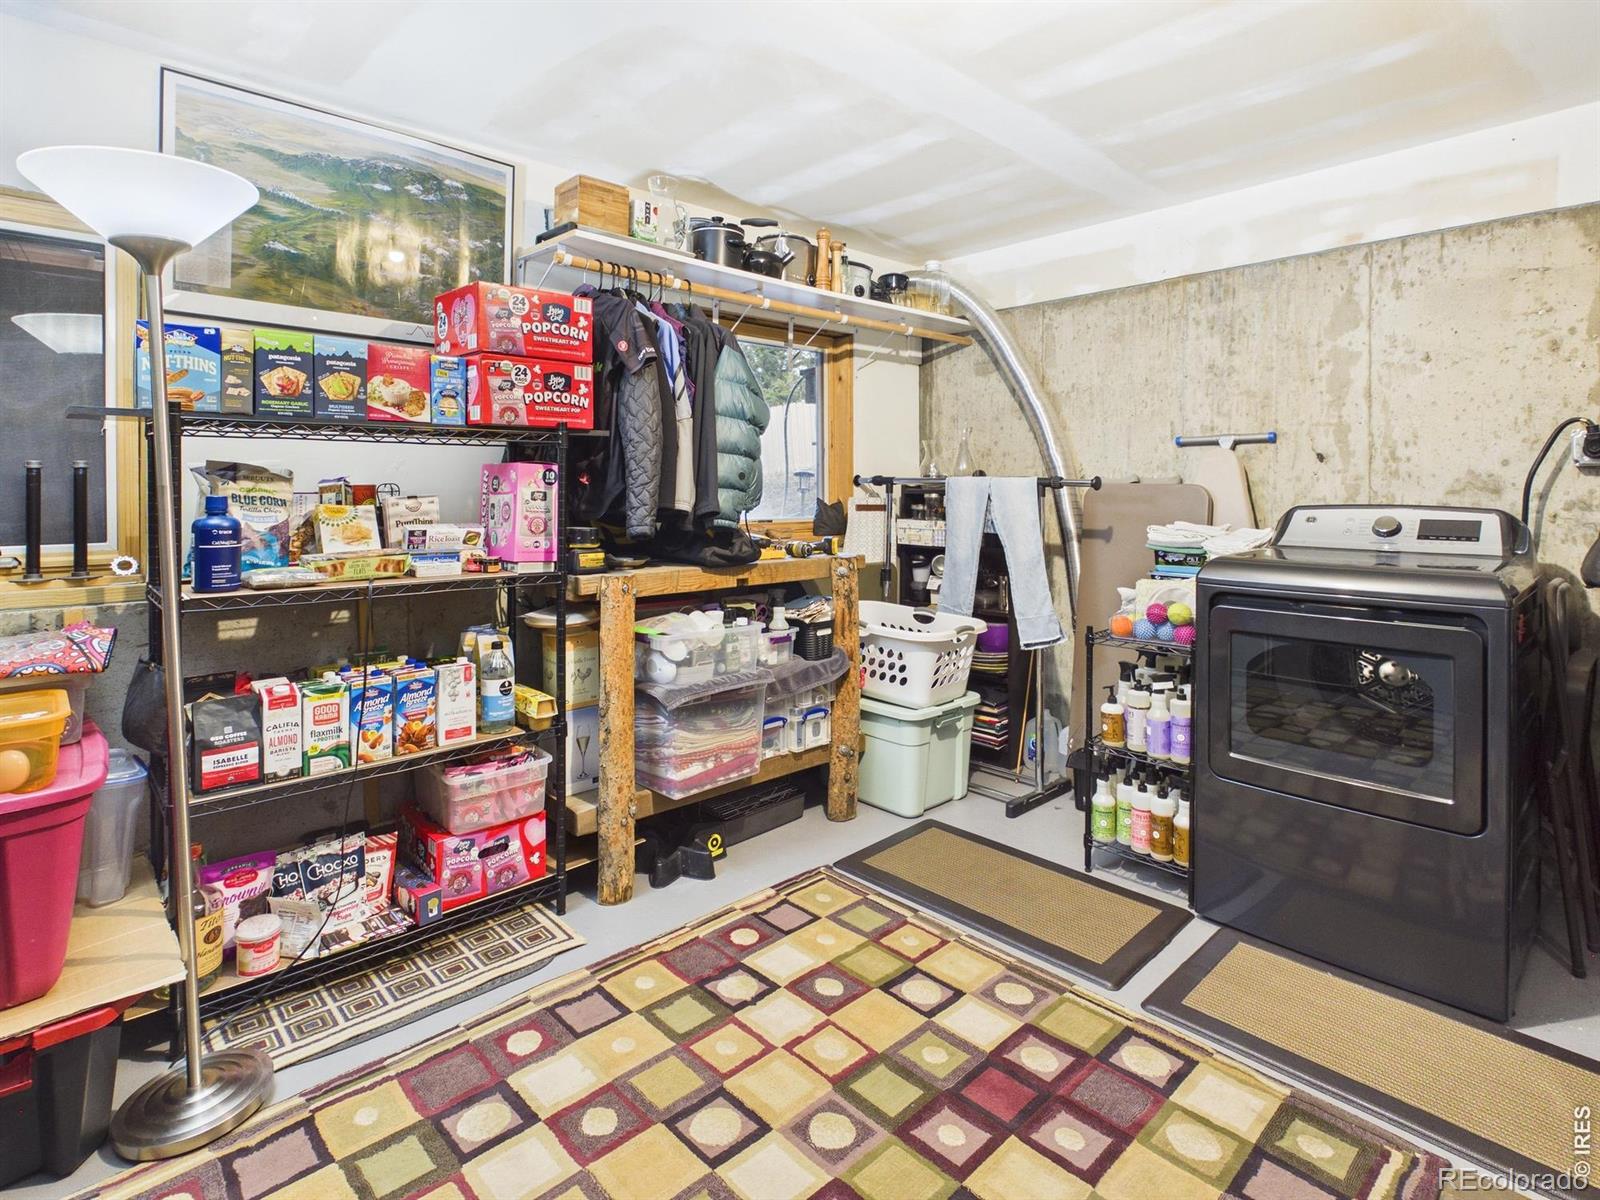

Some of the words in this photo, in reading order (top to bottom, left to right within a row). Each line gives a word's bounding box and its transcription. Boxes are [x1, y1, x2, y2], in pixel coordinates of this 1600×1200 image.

[512, 295, 526, 306] 24
[522, 322, 589, 342] POPCORN
[533, 335, 569, 346] SWEETHEART
[268, 354, 302, 362] patagonia
[141, 354, 218, 375] NT-THINS
[514, 366, 528, 377] 24
[524, 391, 589, 409] POPCORN
[535, 405, 571, 413] SWEETHEART
[545, 472, 555, 480] 10
[239, 487, 277, 495] ORGANIC
[231, 492, 258, 506] BLUE
[258, 495, 287, 508] CORN
[239, 505, 262, 514] Tortilla
[263, 506, 282, 515] Chips
[400, 686, 434, 705] Almond
[314, 703, 338, 714] GOOD
[354, 693, 391, 713] Amond
[314, 711, 338, 721] KARMA
[265, 722, 300, 733] CALIFIA
[310, 726, 343, 739] flaxmilk
[224, 731, 248, 740] COFFEE
[268, 733, 298, 749] ALMOND
[213, 737, 245, 746] ROASTERS
[269, 747, 297, 756] BARISTA
[212, 753, 249, 766] ISABELLE
[225, 862, 252, 873] ORGANIC
[306, 854, 359, 881] CHOCXO
[272, 871, 299, 890] CHO
